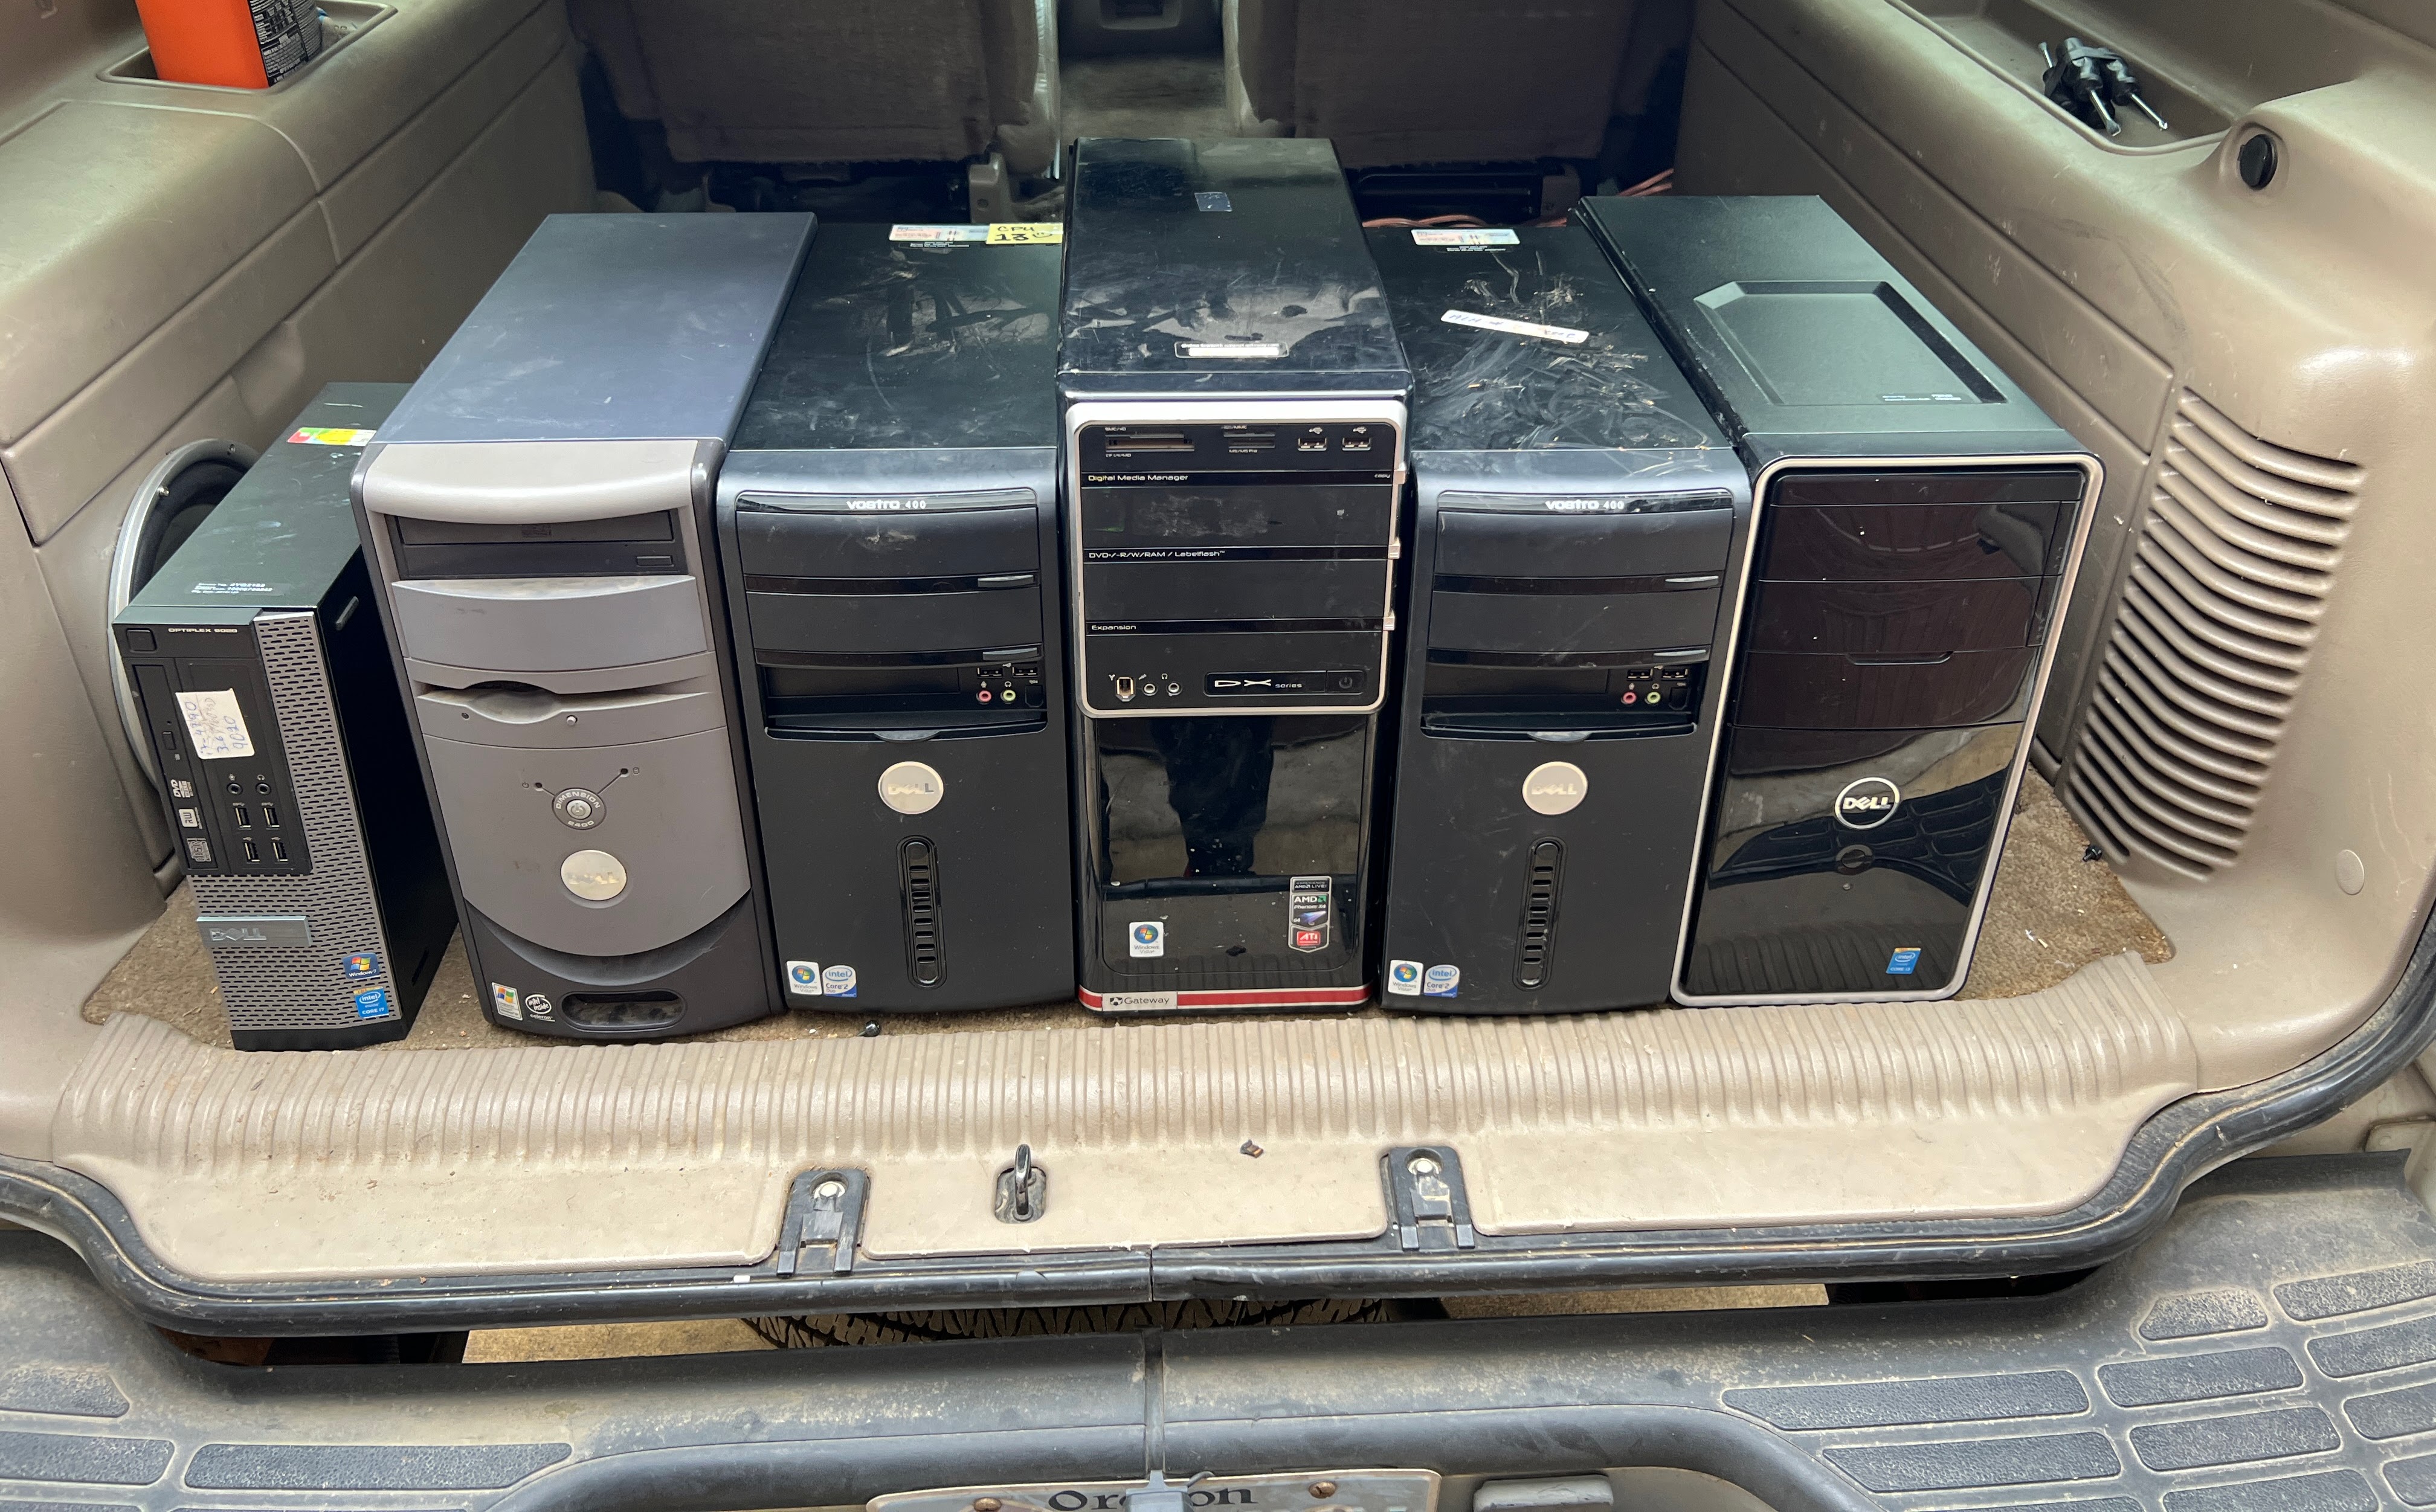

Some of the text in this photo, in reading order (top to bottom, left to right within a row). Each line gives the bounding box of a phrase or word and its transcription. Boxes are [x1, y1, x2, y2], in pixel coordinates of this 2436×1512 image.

[905, 500, 926, 509] 400
[1603, 500, 1625, 509] 400
[1214, 679, 1272, 687] DX
[170, 779, 181, 797] DVD
[1532, 783, 1577, 796] DELL
[555, 791, 601, 809] DIMENSION
[1843, 796, 1891, 810] DELL
[182, 812, 194, 824] RW
[209, 928, 267, 941] DELL
[1048, 1488, 1258, 1511] Oron
